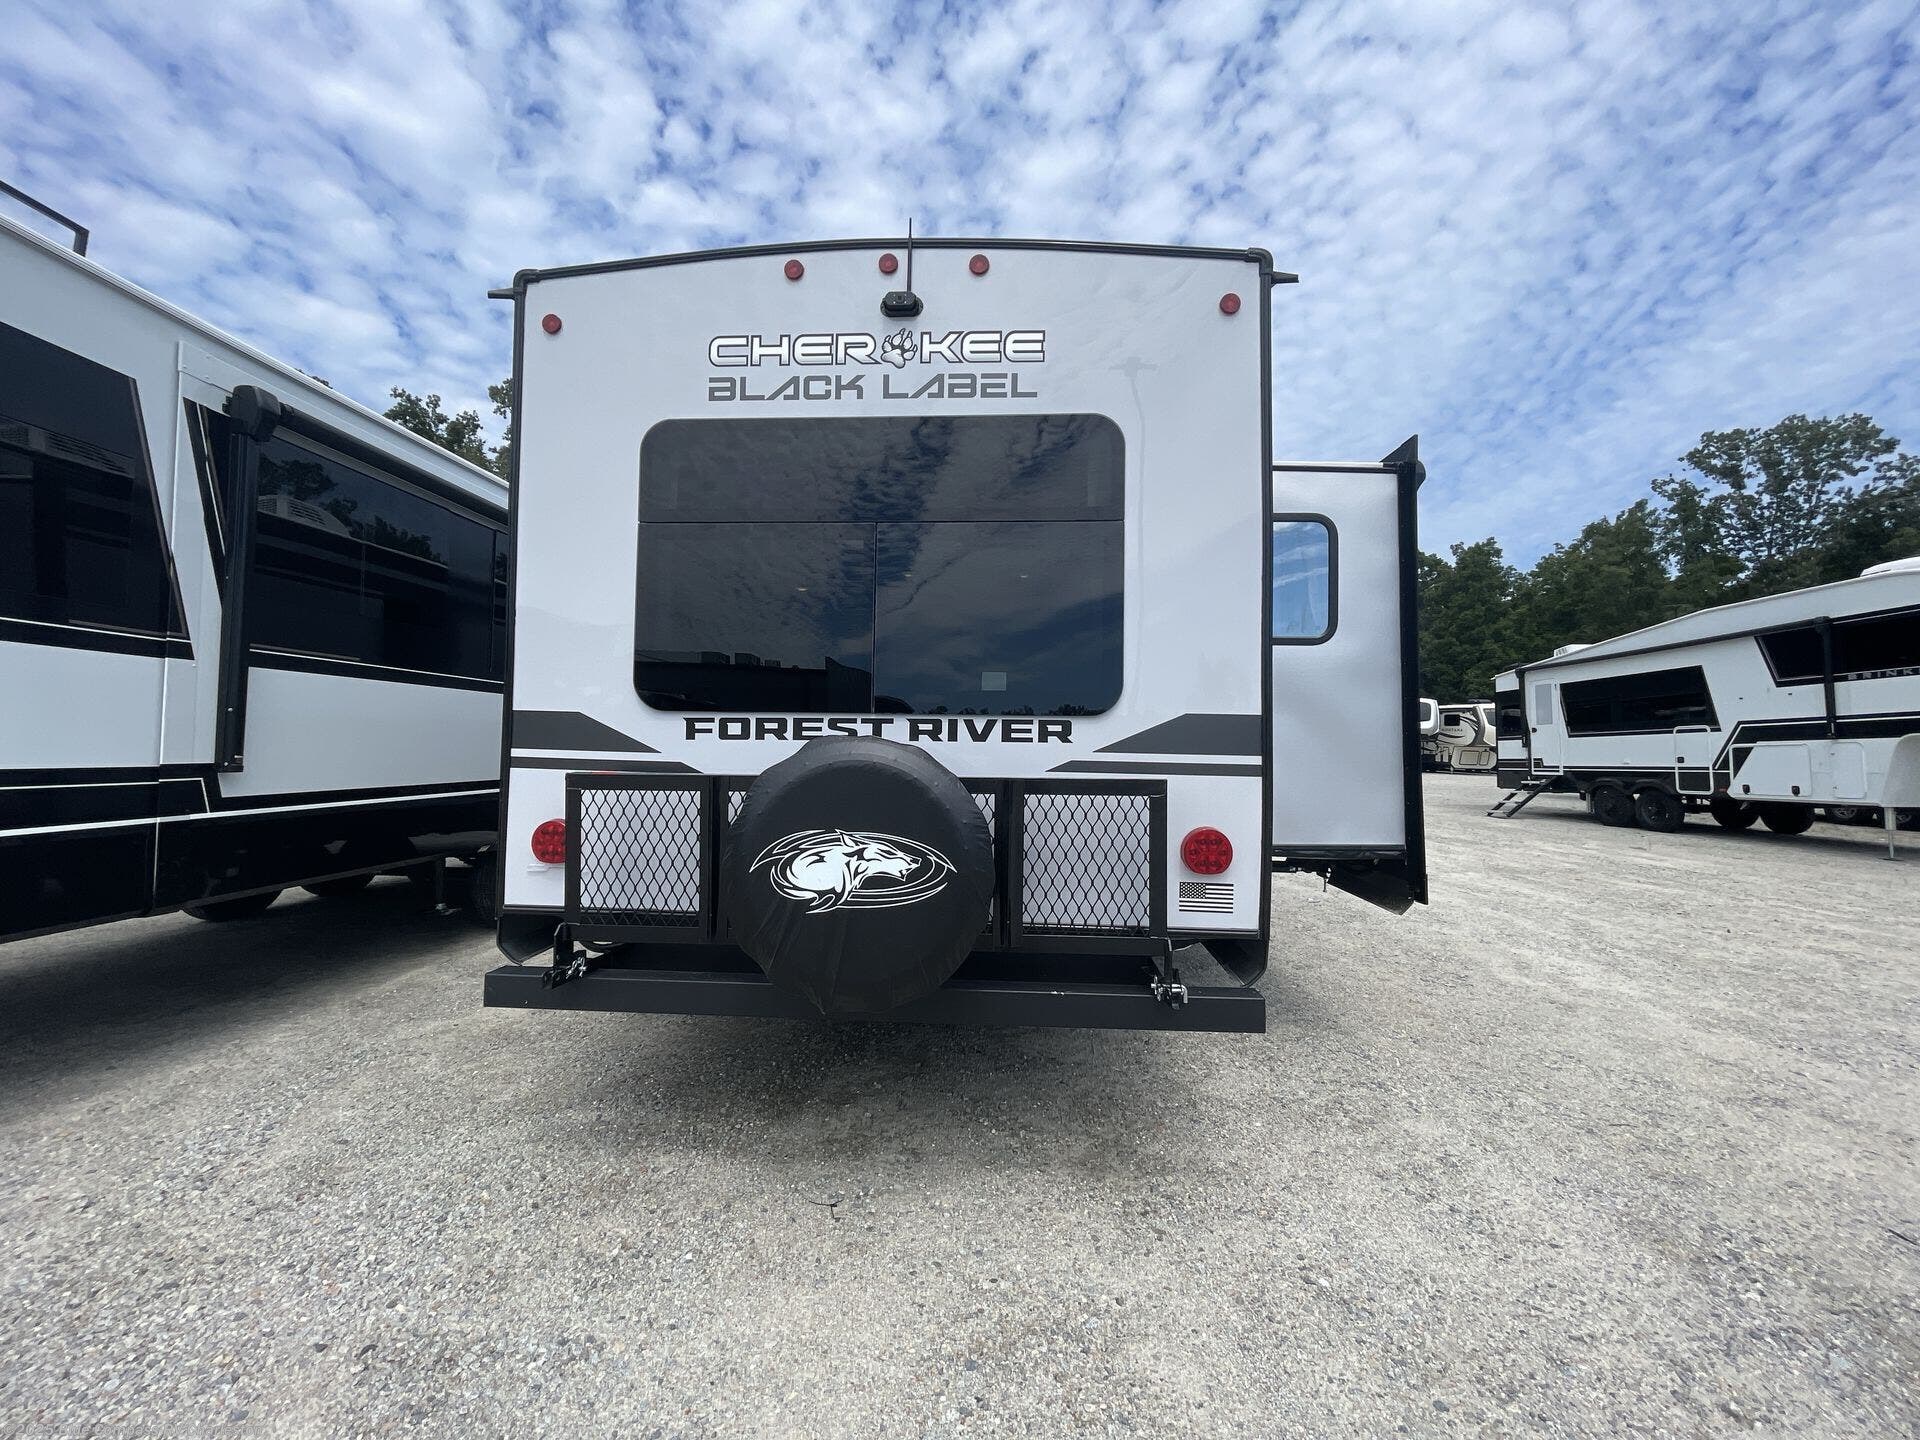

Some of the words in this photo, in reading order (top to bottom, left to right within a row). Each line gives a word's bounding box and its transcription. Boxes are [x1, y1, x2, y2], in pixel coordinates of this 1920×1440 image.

[708, 374, 866, 401] BLACK
[882, 373, 1038, 399] LABEL
[1848, 667, 1920, 681] BRINK
[683, 717, 895, 741] FOREST
[906, 718, 1073, 743] RIVER
